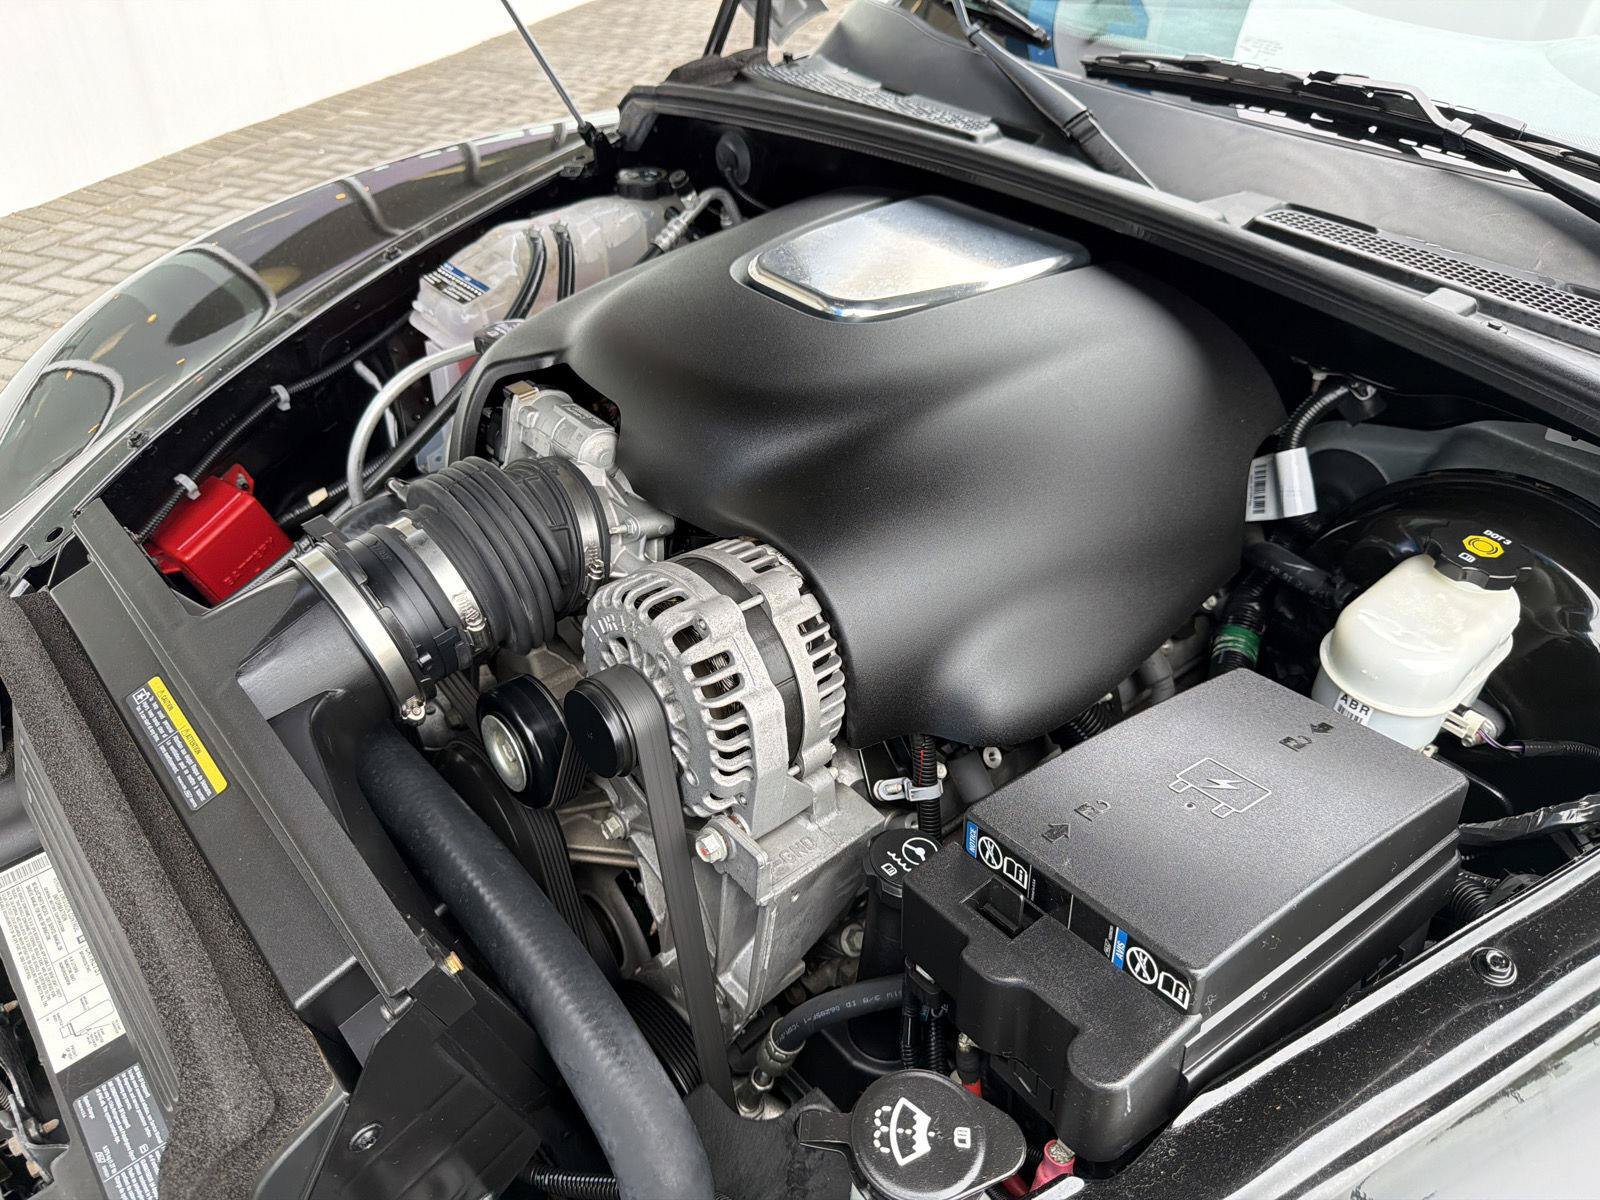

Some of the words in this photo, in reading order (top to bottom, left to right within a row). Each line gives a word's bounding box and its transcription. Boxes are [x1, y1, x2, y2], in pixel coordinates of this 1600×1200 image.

[1483, 529, 1506, 541] DOT
[1340, 694, 1370, 716] ABR
[968, 827, 979, 853] NOTICE
[1115, 941, 1126, 961] AVIS
